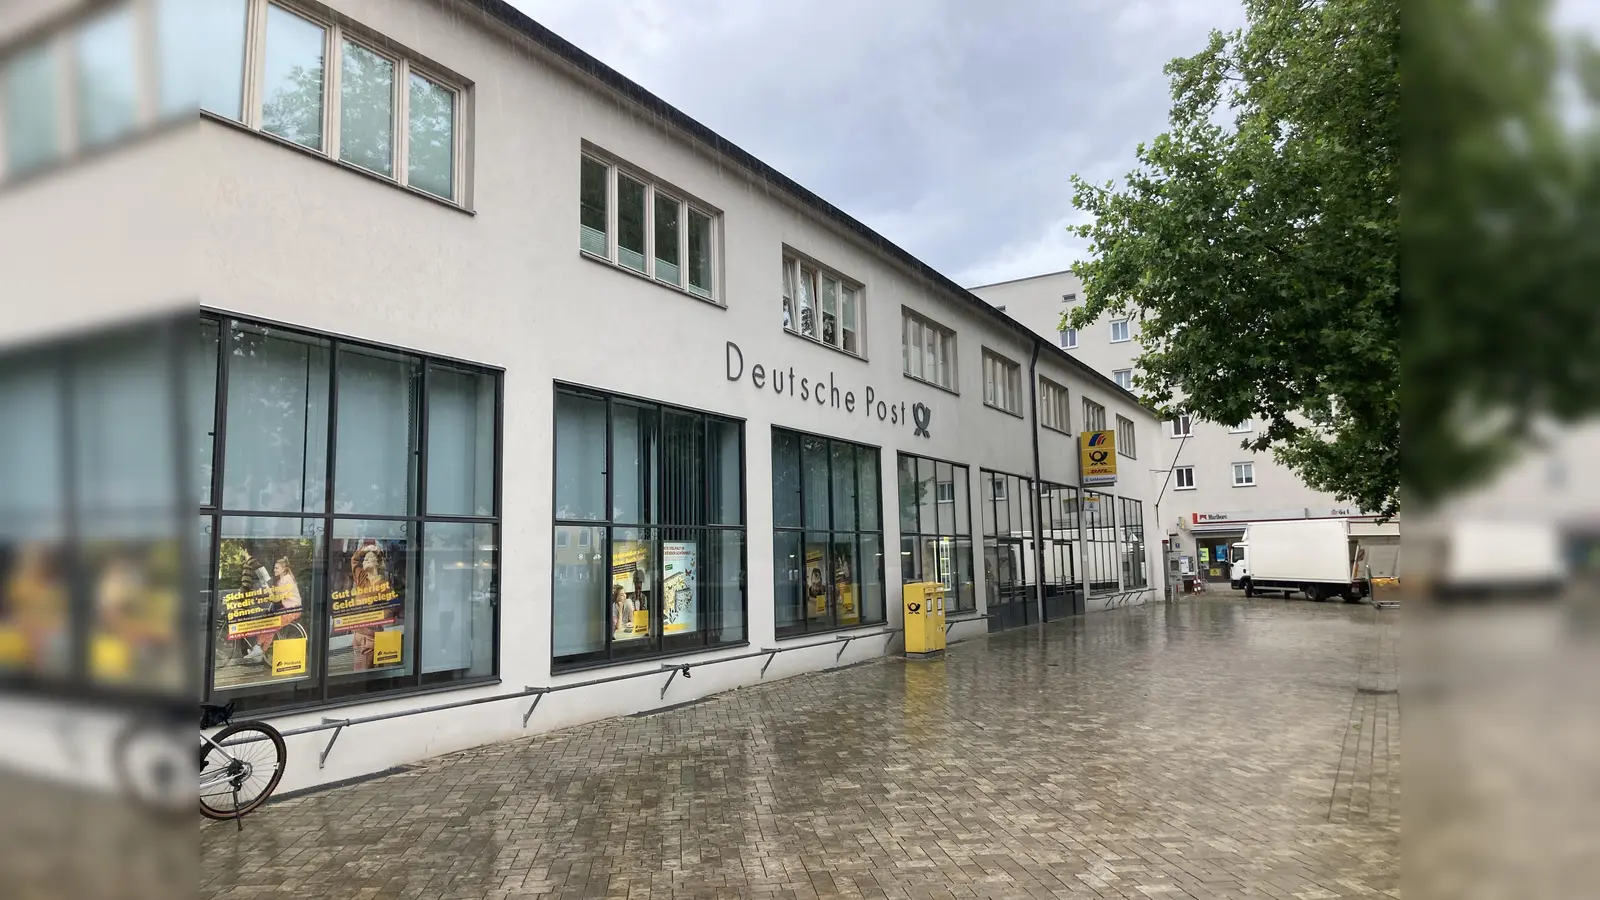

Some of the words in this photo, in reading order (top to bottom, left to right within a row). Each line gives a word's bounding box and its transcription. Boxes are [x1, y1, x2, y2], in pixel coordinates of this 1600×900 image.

[726, 340, 856, 413] Deutsche
[866, 386, 906, 425] Post
[225, 592, 244, 603] Sich
[245, 587, 262, 597] und
[331, 589, 350, 600] Gut
[351, 581, 391, 596] überlegt
[226, 598, 255, 610] Kredit
[332, 598, 355, 611] Geld
[355, 590, 399, 605] angelegt.
[227, 607, 264, 621] gönnen.
